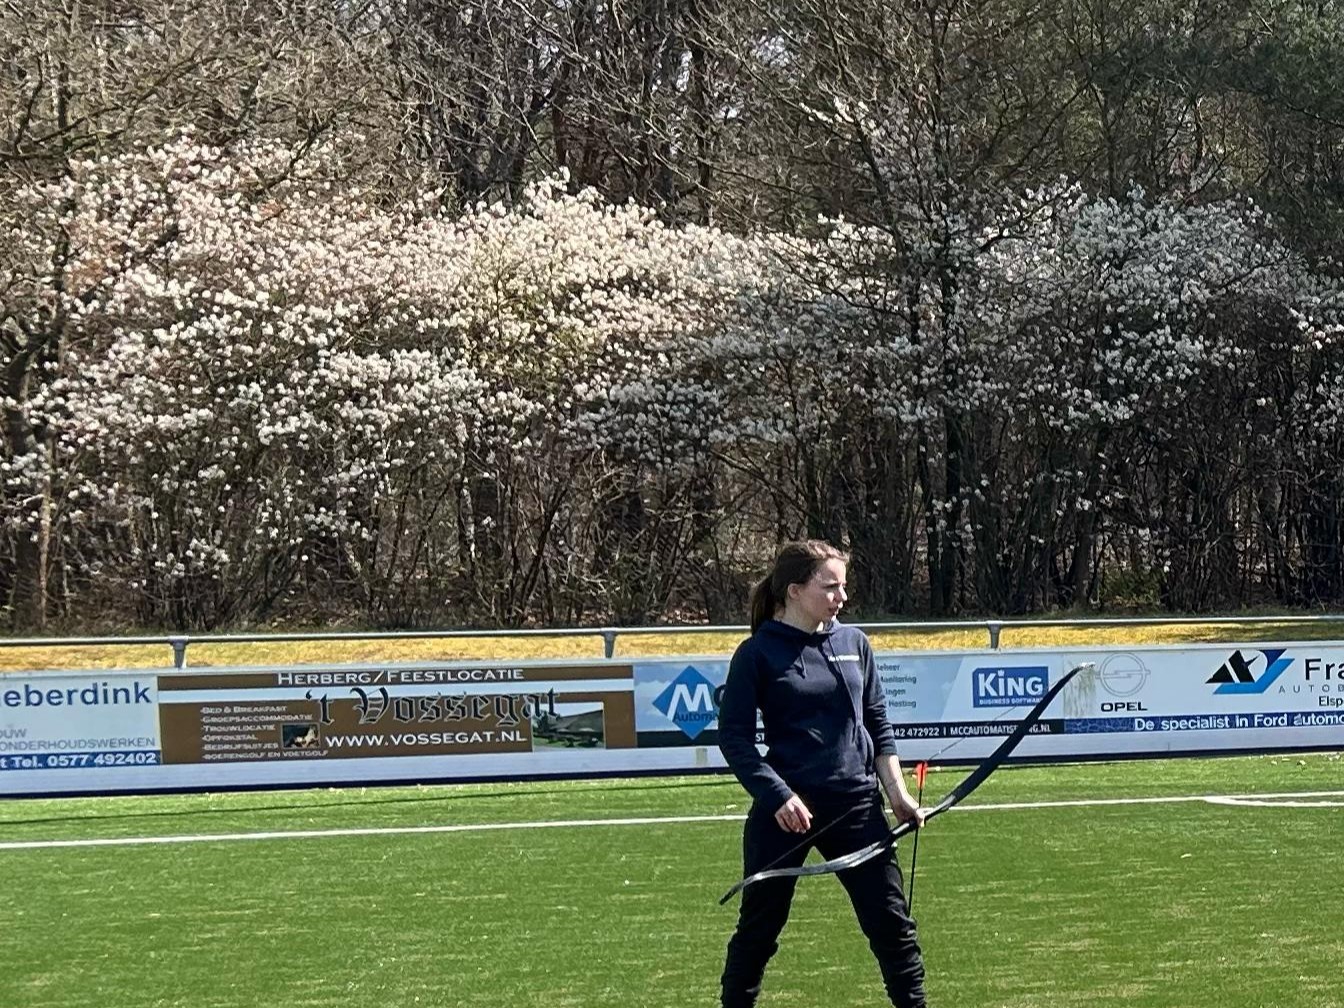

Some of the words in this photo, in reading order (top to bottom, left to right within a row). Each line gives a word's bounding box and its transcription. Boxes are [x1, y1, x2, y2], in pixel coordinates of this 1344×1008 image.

[349, 686, 562, 728] Vossegat
[1100, 701, 1148, 712] OPEL
[1134, 717, 1155, 731] De
[1161, 716, 1230, 732] specialist
[1235, 715, 1249, 729] in
[1253, 713, 1288, 728] Ford
[325, 730, 528, 748] WWW.VOSSEGAT.NL
[907, 727, 939, 737] 472922
[0, 737, 156, 752] ONDERHOUDSWERKEN
[11, 756, 43, 769] Tel.
[46, 753, 90, 768] 0577
[93, 751, 157, 766] 492402
